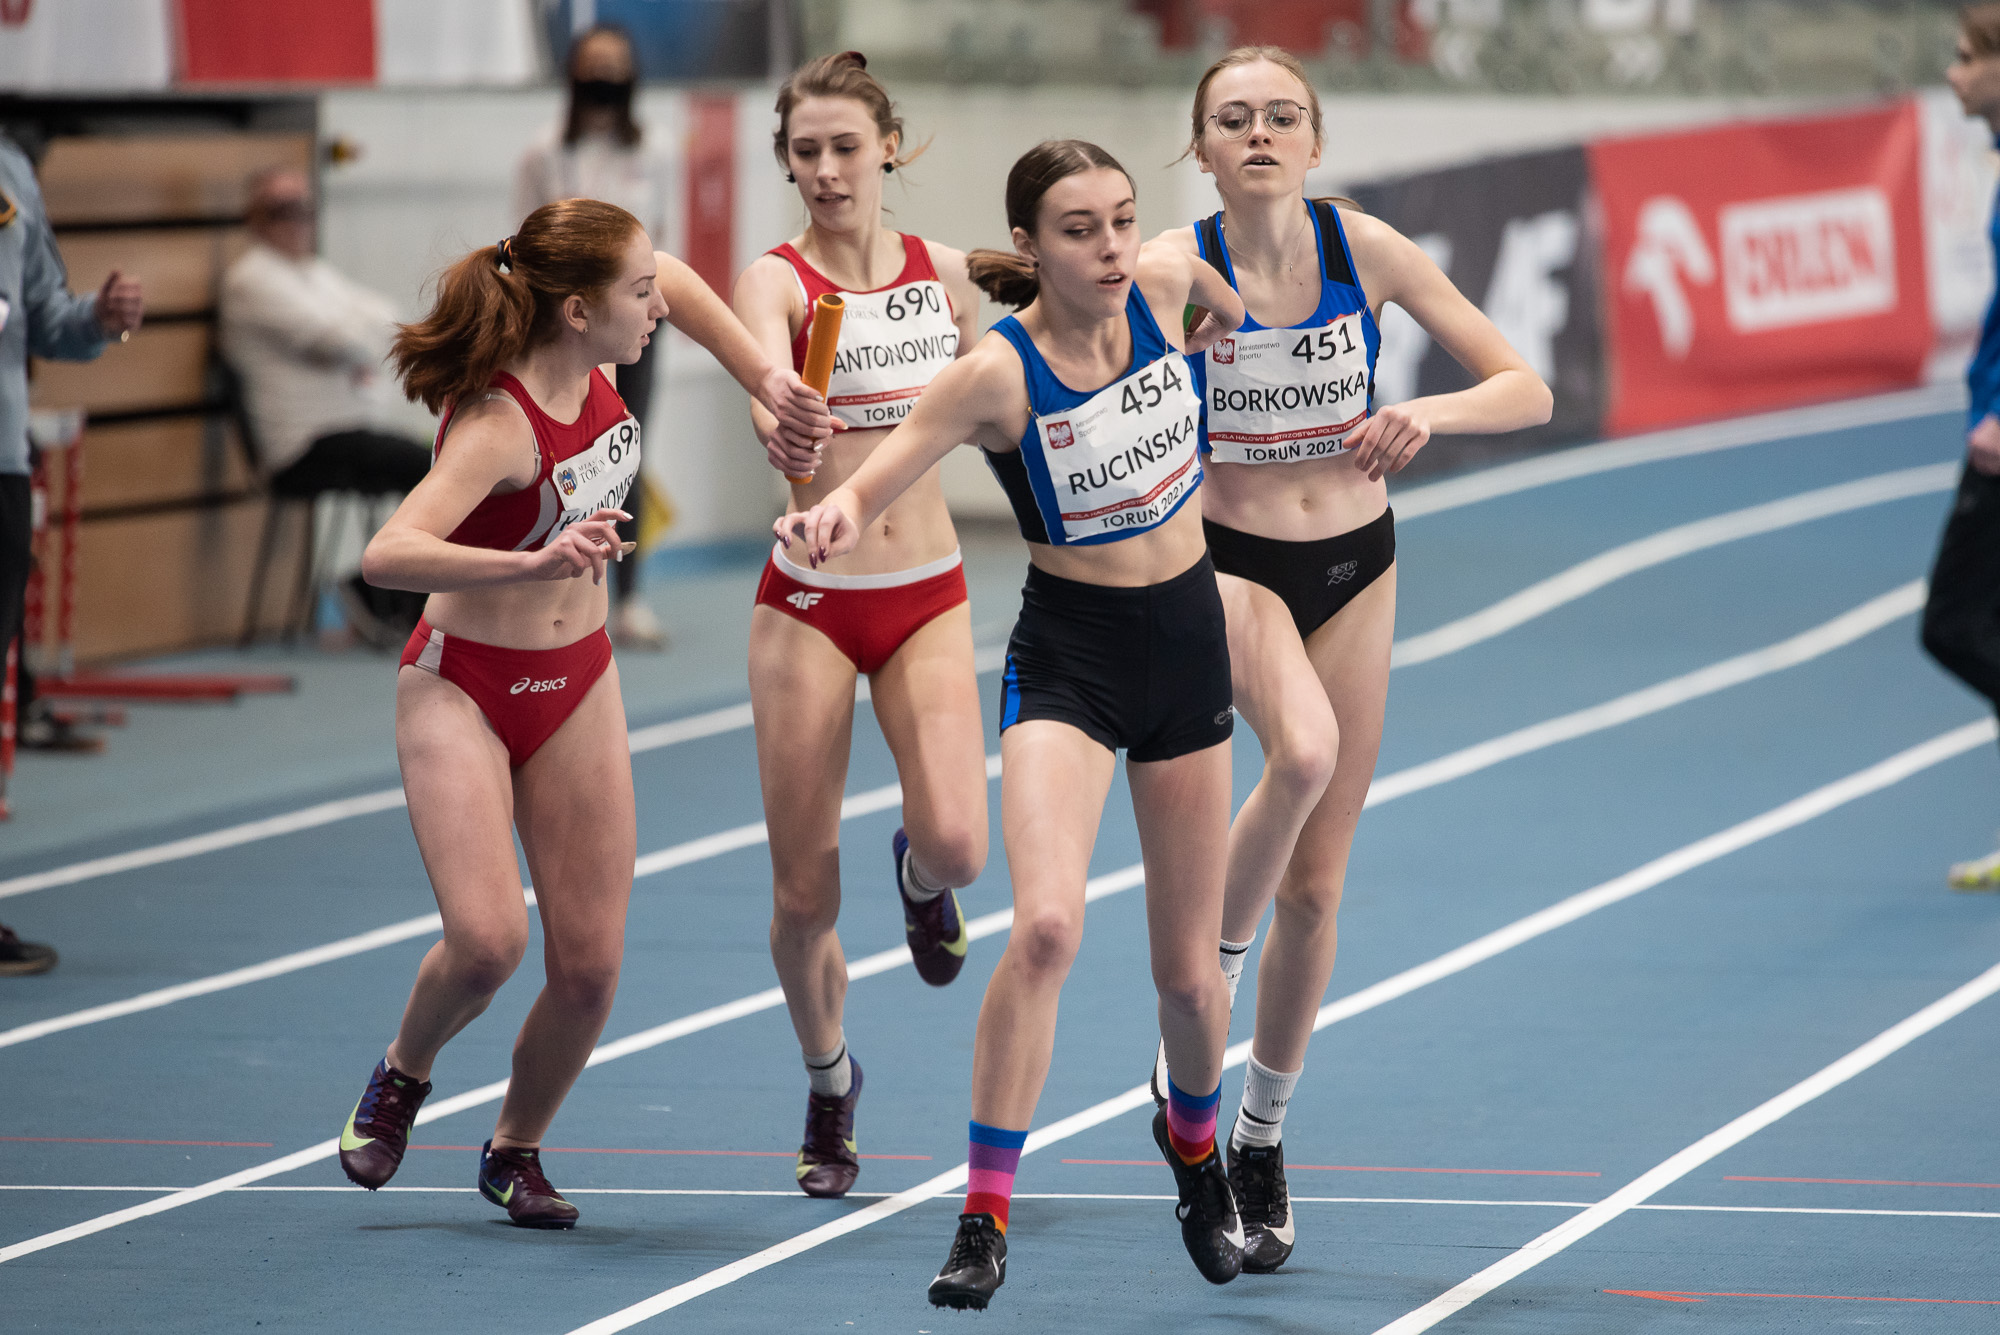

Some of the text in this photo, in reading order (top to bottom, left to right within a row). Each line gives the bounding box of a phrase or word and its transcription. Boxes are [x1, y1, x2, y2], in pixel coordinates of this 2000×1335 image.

[886, 285, 940, 321] 690
[1291, 322, 1356, 364] 451
[1120, 361, 1182, 415] 454
[1213, 371, 1366, 412] BORKOWSKA
[1244, 437, 1343, 462] TORUŃ 2021
[1266, 431, 1317, 443] MISTRZOSTWA
[1317, 426, 1343, 435] POLSKI
[1068, 415, 1194, 496] RUCIŃSKA
[1101, 481, 1184, 528] TORUŃ 2021
[786, 591, 824, 610] 4F
[529, 676, 568, 693] asics
